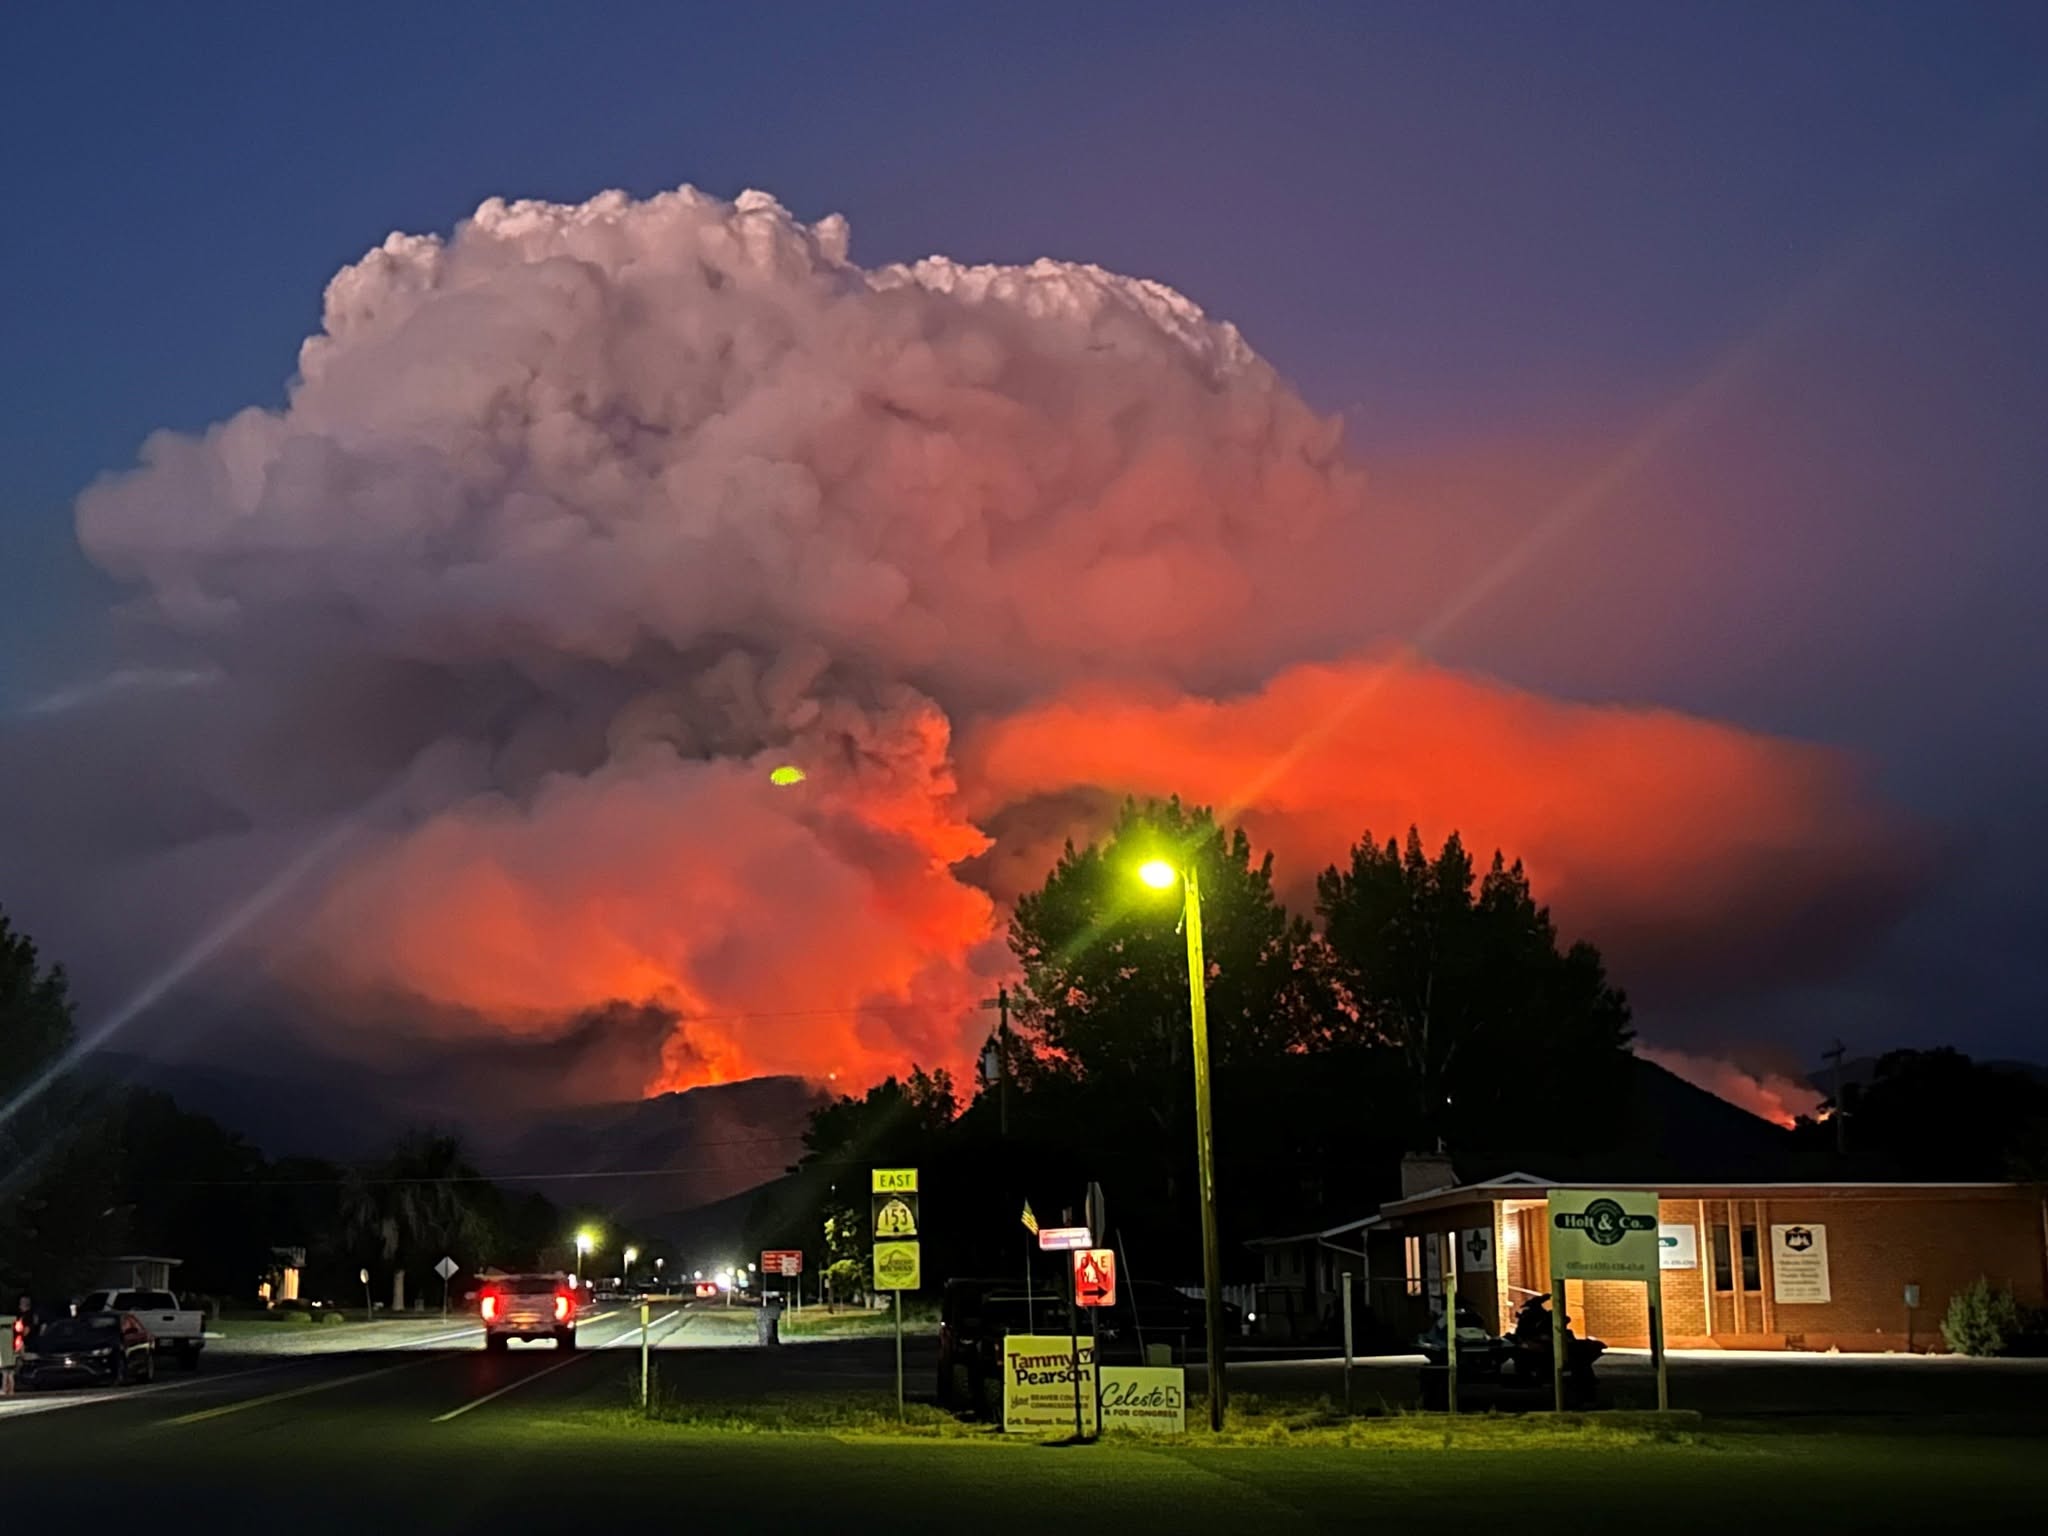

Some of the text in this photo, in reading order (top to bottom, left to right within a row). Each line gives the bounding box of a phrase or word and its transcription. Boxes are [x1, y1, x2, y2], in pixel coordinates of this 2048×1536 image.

[880, 1175, 911, 1187] EAST
[884, 1209, 908, 1227] 153
[1565, 1213, 1644, 1230] Holt & Co.
[1008, 1352, 1073, 1370] Tammy
[1015, 1369, 1090, 1386] Pearson
[1100, 1382, 1164, 1408] Celeste
[1132, 1410, 1178, 1418] CONGRESS
